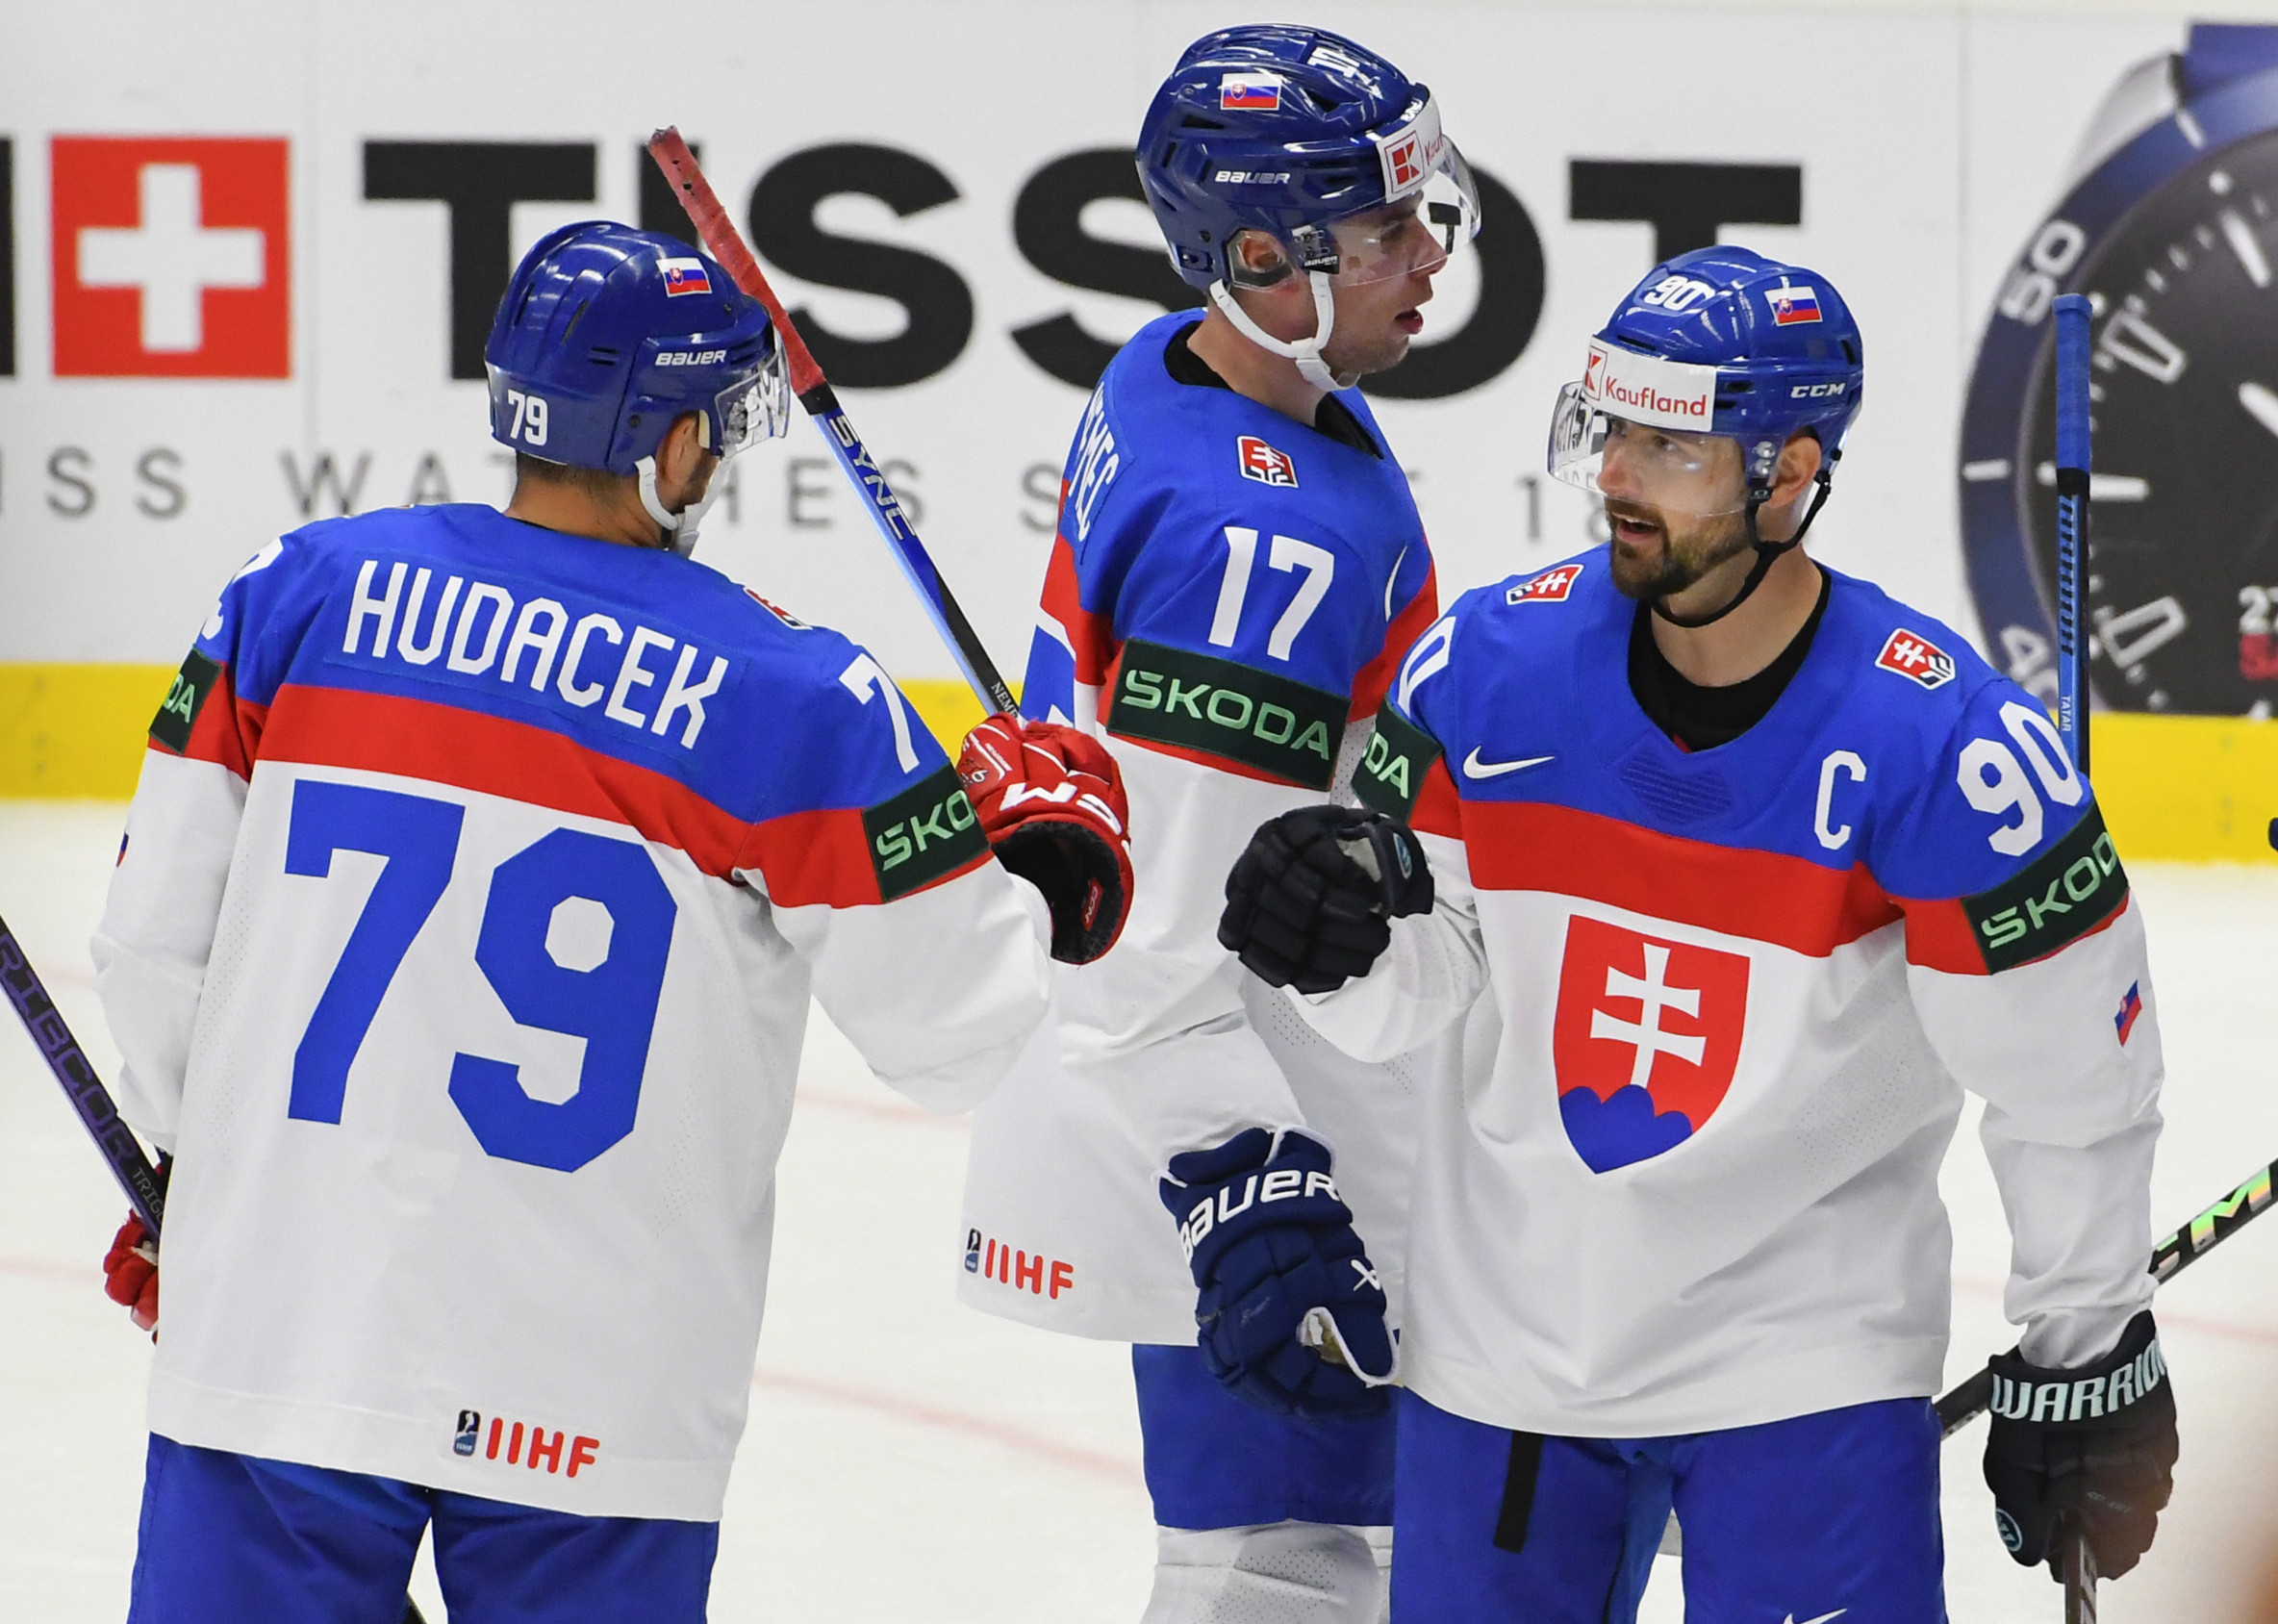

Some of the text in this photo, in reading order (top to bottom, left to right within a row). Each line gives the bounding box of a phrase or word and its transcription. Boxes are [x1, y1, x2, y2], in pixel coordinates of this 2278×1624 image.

[1214, 170, 1291, 185] BAUER
[362, 140, 1804, 400] TSSOT
[1643, 274, 1705, 312] 90
[654, 349, 727, 367] BAUER
[507, 389, 548, 447] 79
[1605, 375, 1708, 417] Kaufland
[1789, 382, 1846, 399] CCM
[828, 414, 917, 541] SYNC
[1208, 526, 1336, 662] 17
[342, 559, 729, 749] HUDACEK
[1122, 668, 1331, 762] SKODA
[2061, 694, 2072, 732] TATAR
[1813, 749, 1867, 851] C
[1956, 700, 2084, 857] 90
[284, 777, 678, 1174] 79
[984, 1237, 1075, 1300] IIHF
[485, 1416, 601, 1479] IIHF
